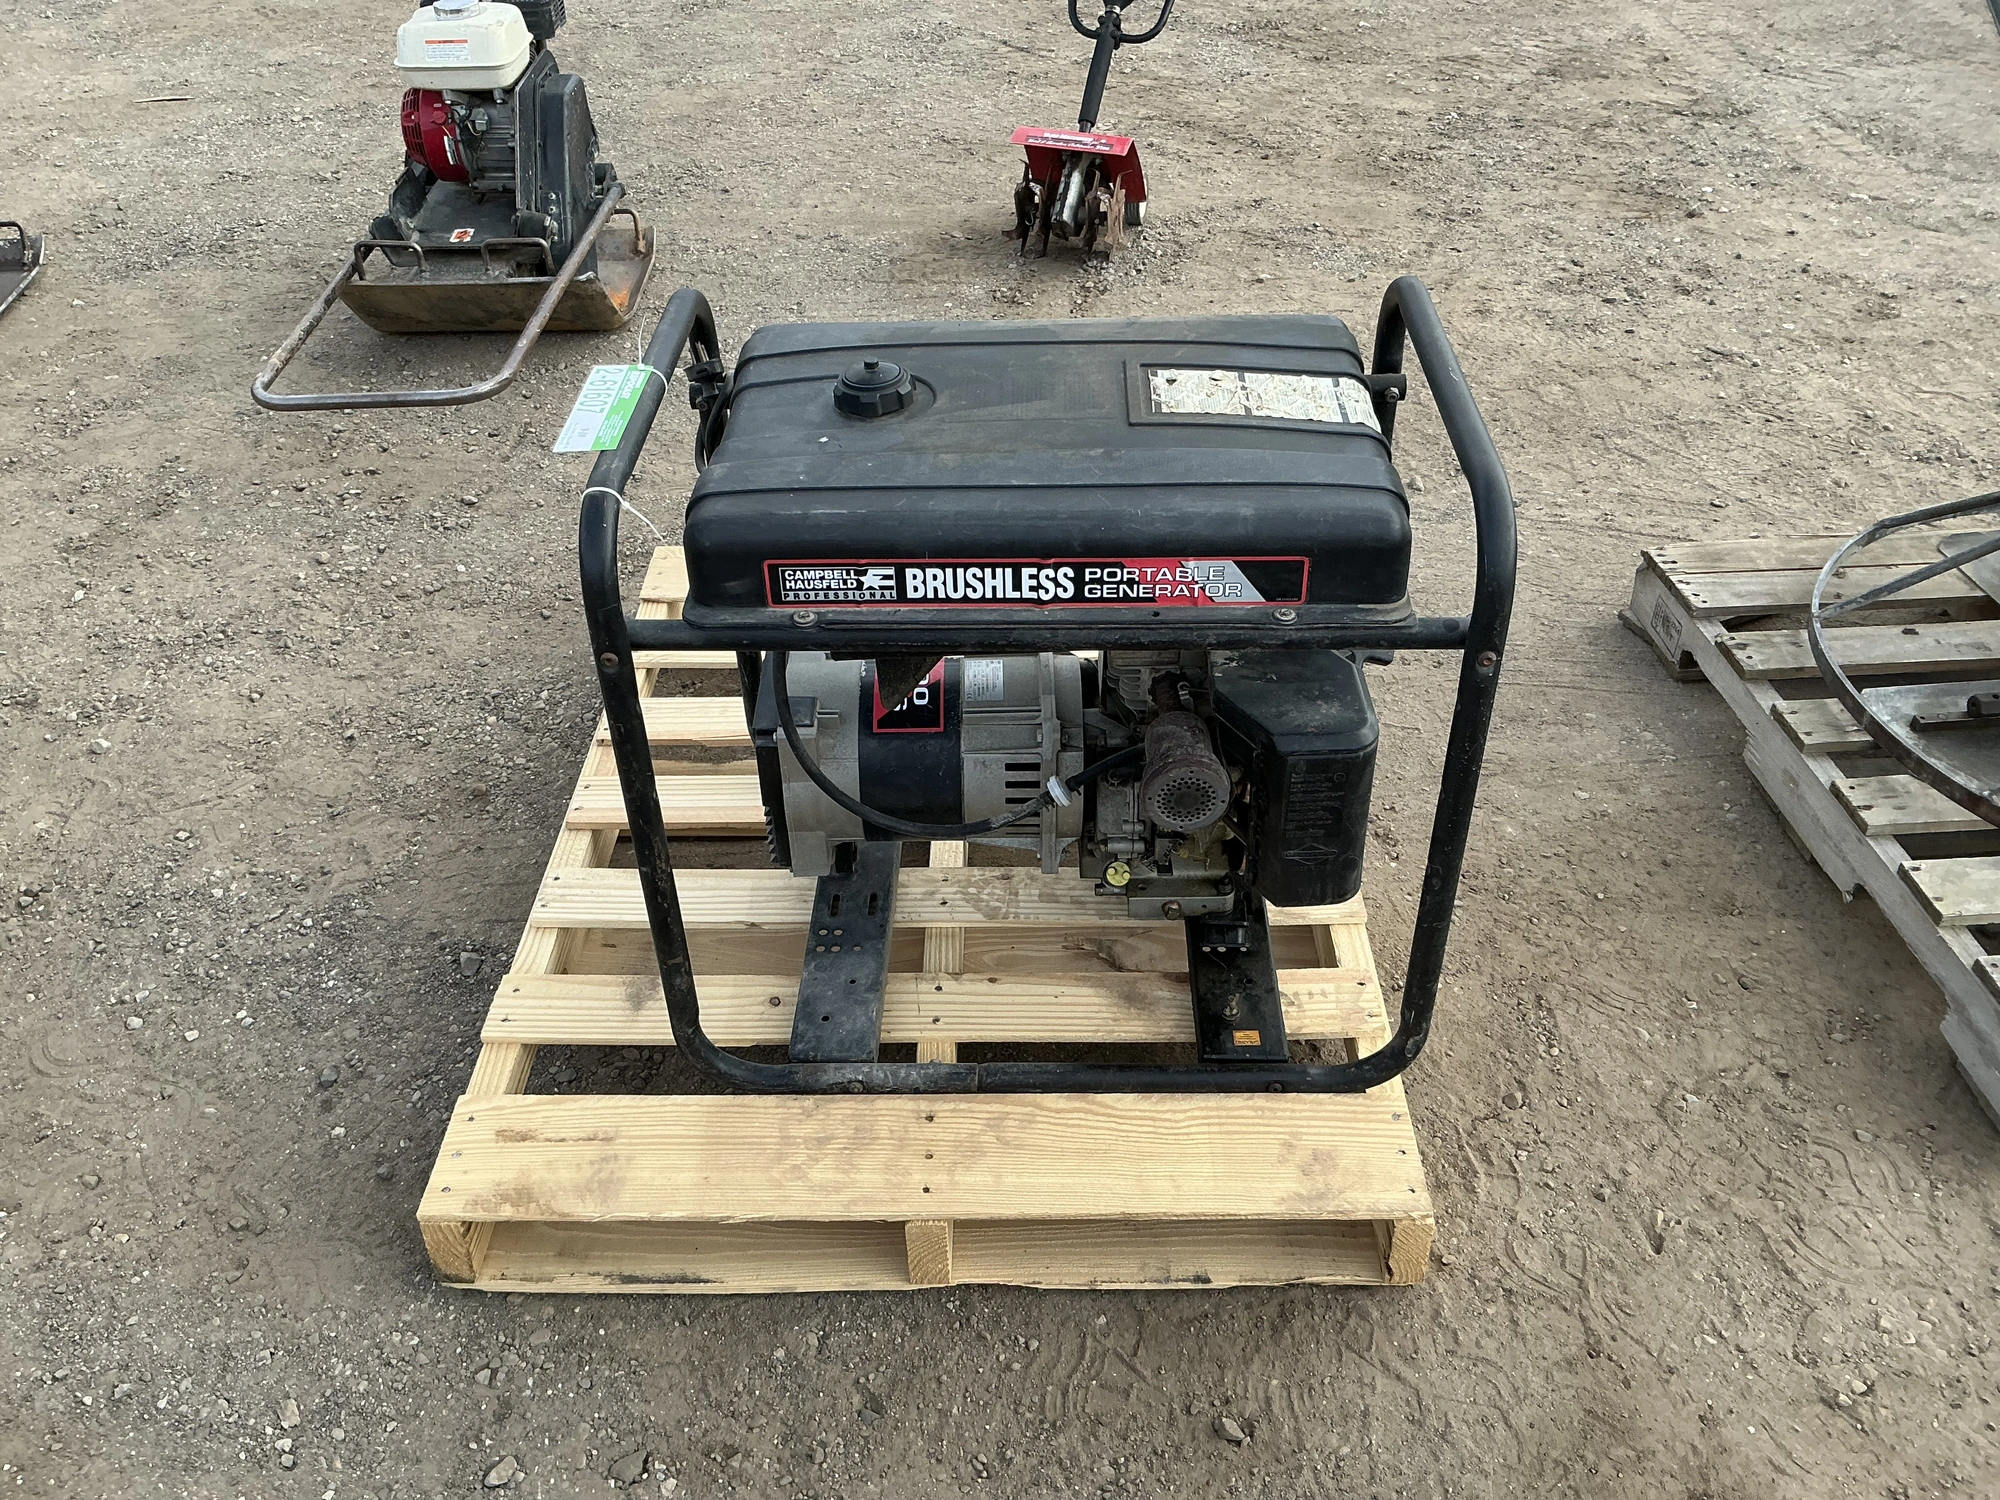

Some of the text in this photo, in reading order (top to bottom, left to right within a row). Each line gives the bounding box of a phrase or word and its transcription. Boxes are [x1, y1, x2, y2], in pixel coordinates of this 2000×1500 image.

[576, 368, 624, 414] 2-61607
[784, 569, 859, 580] CAMPBELL
[1084, 566, 1226, 582] PORTABLE
[785, 579, 858, 590] HAUSFELD
[904, 566, 1075, 601] BRUSHLESS
[1084, 583, 1243, 598] GENERATOR
[783, 591, 897, 600] PROFESSIONAL
